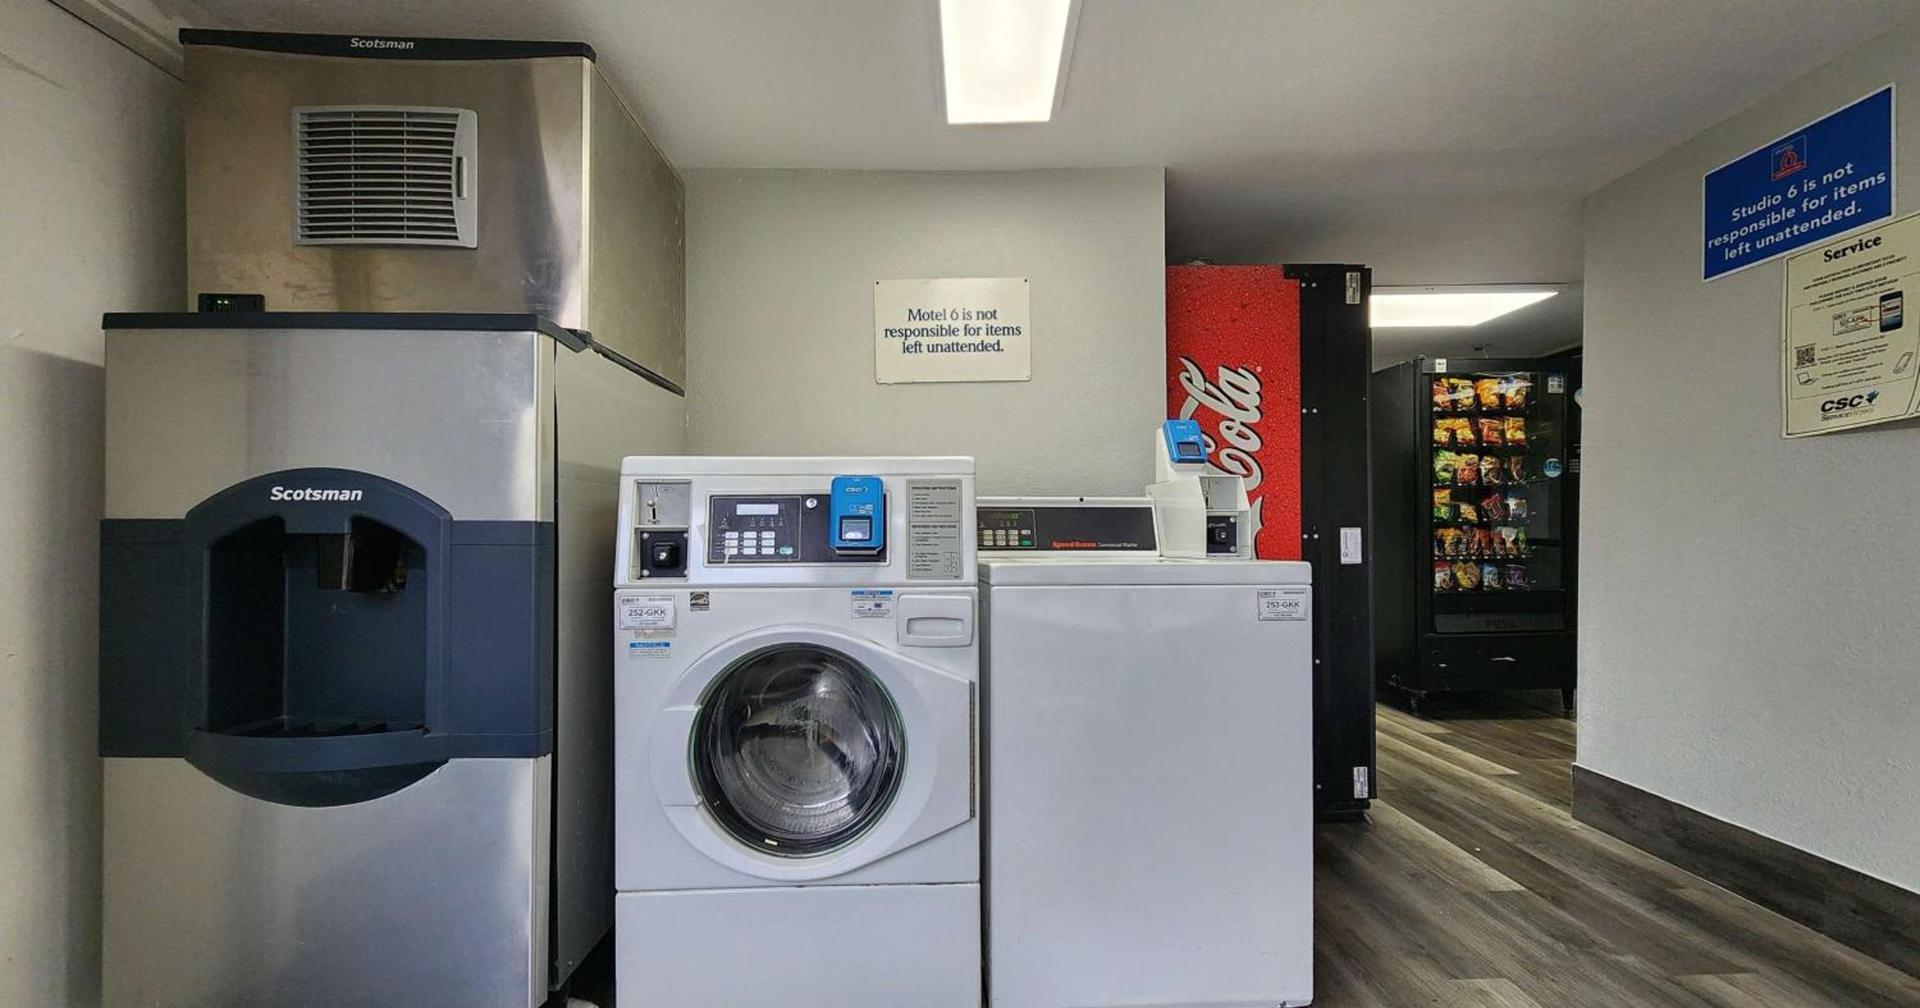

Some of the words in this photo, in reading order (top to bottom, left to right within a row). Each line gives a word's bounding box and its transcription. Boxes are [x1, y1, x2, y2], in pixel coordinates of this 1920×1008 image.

[350, 37, 415, 50] Scotsman
[1731, 194, 1782, 222] Studio
[1787, 184, 1798, 199] 6
[1803, 179, 1817, 193] is
[1822, 162, 1854, 185] not
[1708, 207, 1796, 249] responsible
[1801, 194, 1827, 213] for
[1833, 171, 1887, 201] items
[1724, 241, 1751, 261] left
[1756, 201, 1862, 249] unattended.
[1823, 236, 1882, 263] Service
[907, 308, 947, 322] Motel
[950, 307, 959, 321] 6
[962, 307, 973, 321] is
[976, 308, 998, 321] not
[884, 324, 960, 340] responsible
[963, 324, 982, 337] for
[985, 323, 1022, 337] items
[902, 341, 923, 354] left
[927, 340, 1005, 353] unattended.
[1820, 394, 1865, 413] CSC
[269, 485, 363, 502] Scotsman
[628, 608, 667, 617] 252-GKK
